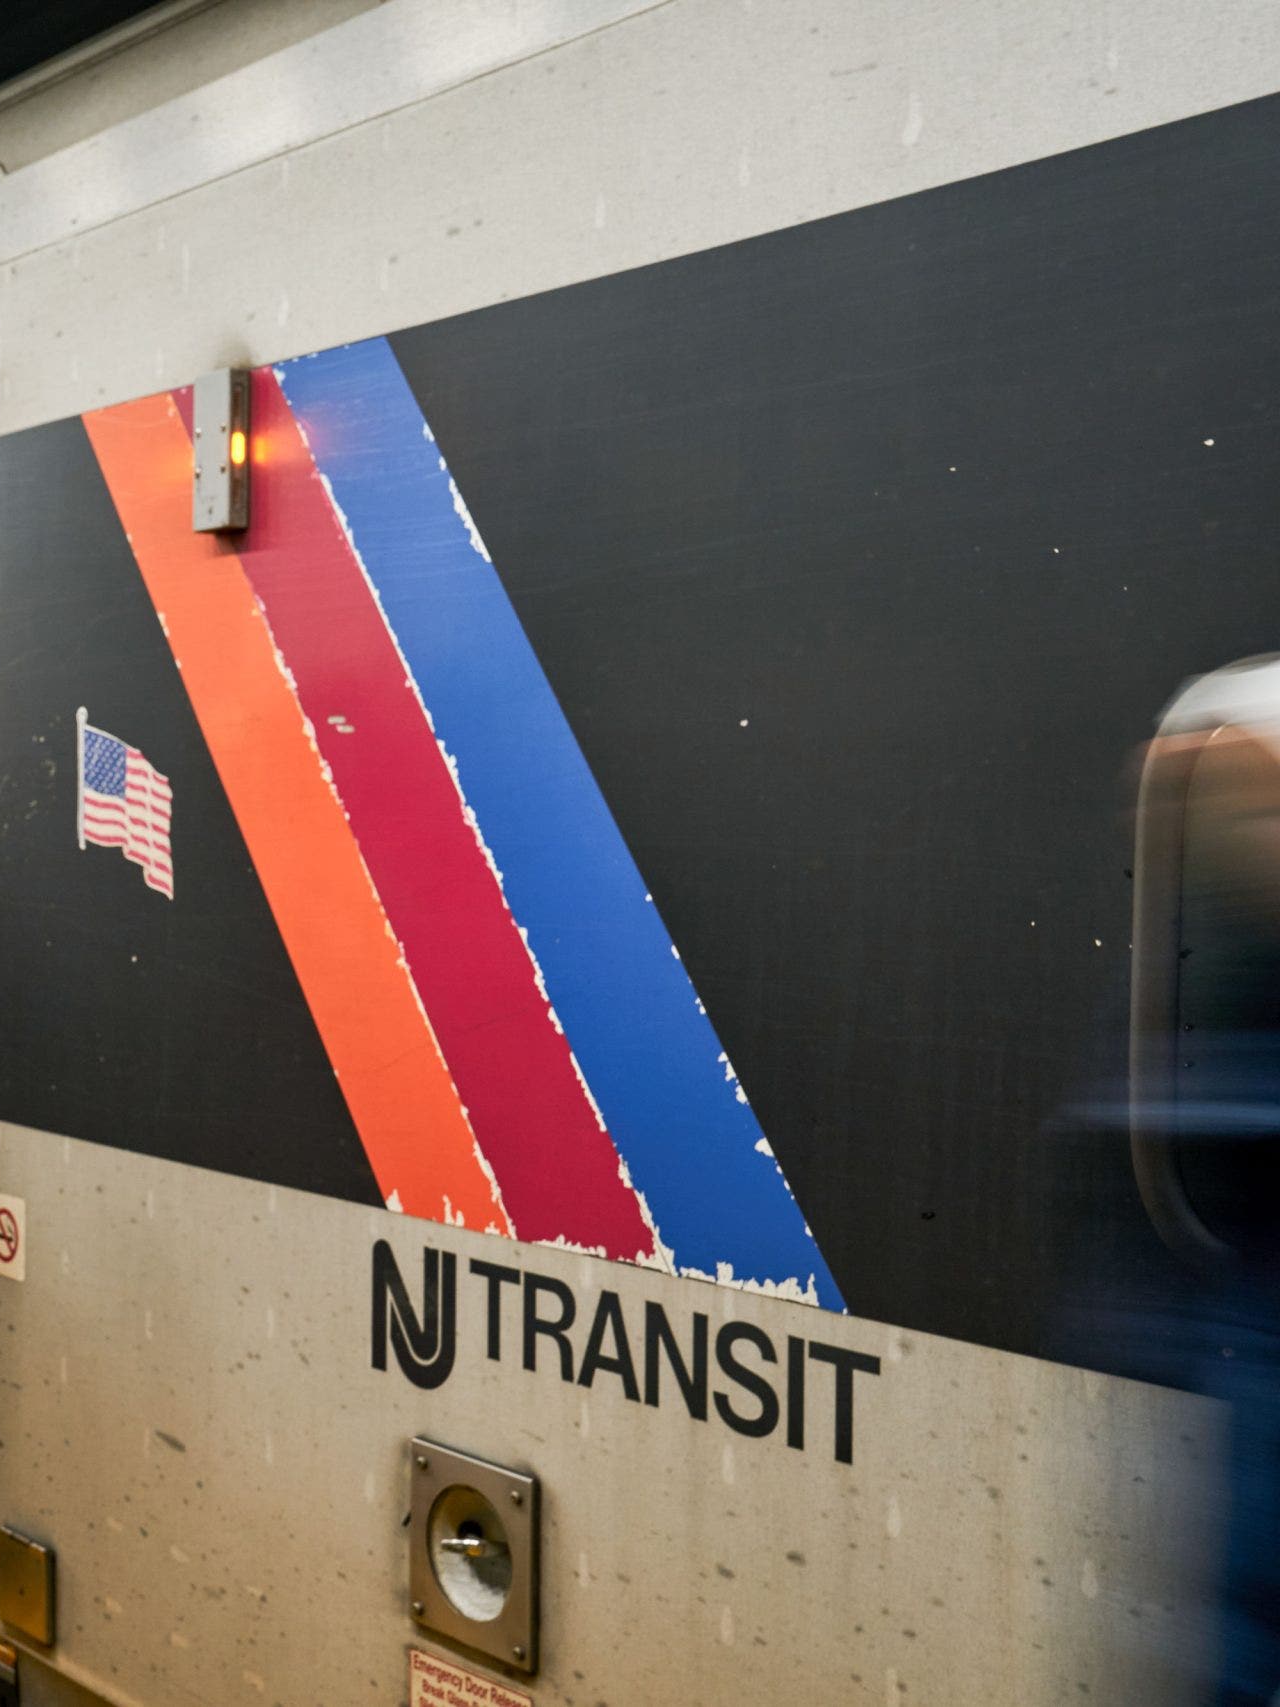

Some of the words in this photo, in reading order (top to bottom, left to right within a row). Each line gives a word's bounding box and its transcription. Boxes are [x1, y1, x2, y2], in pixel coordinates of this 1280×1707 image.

[371, 1239, 457, 1390] NJ
[469, 1258, 881, 1465] TRANSIT
[414, 1653, 463, 1692] Emergency
[465, 1676, 488, 1698] Door
